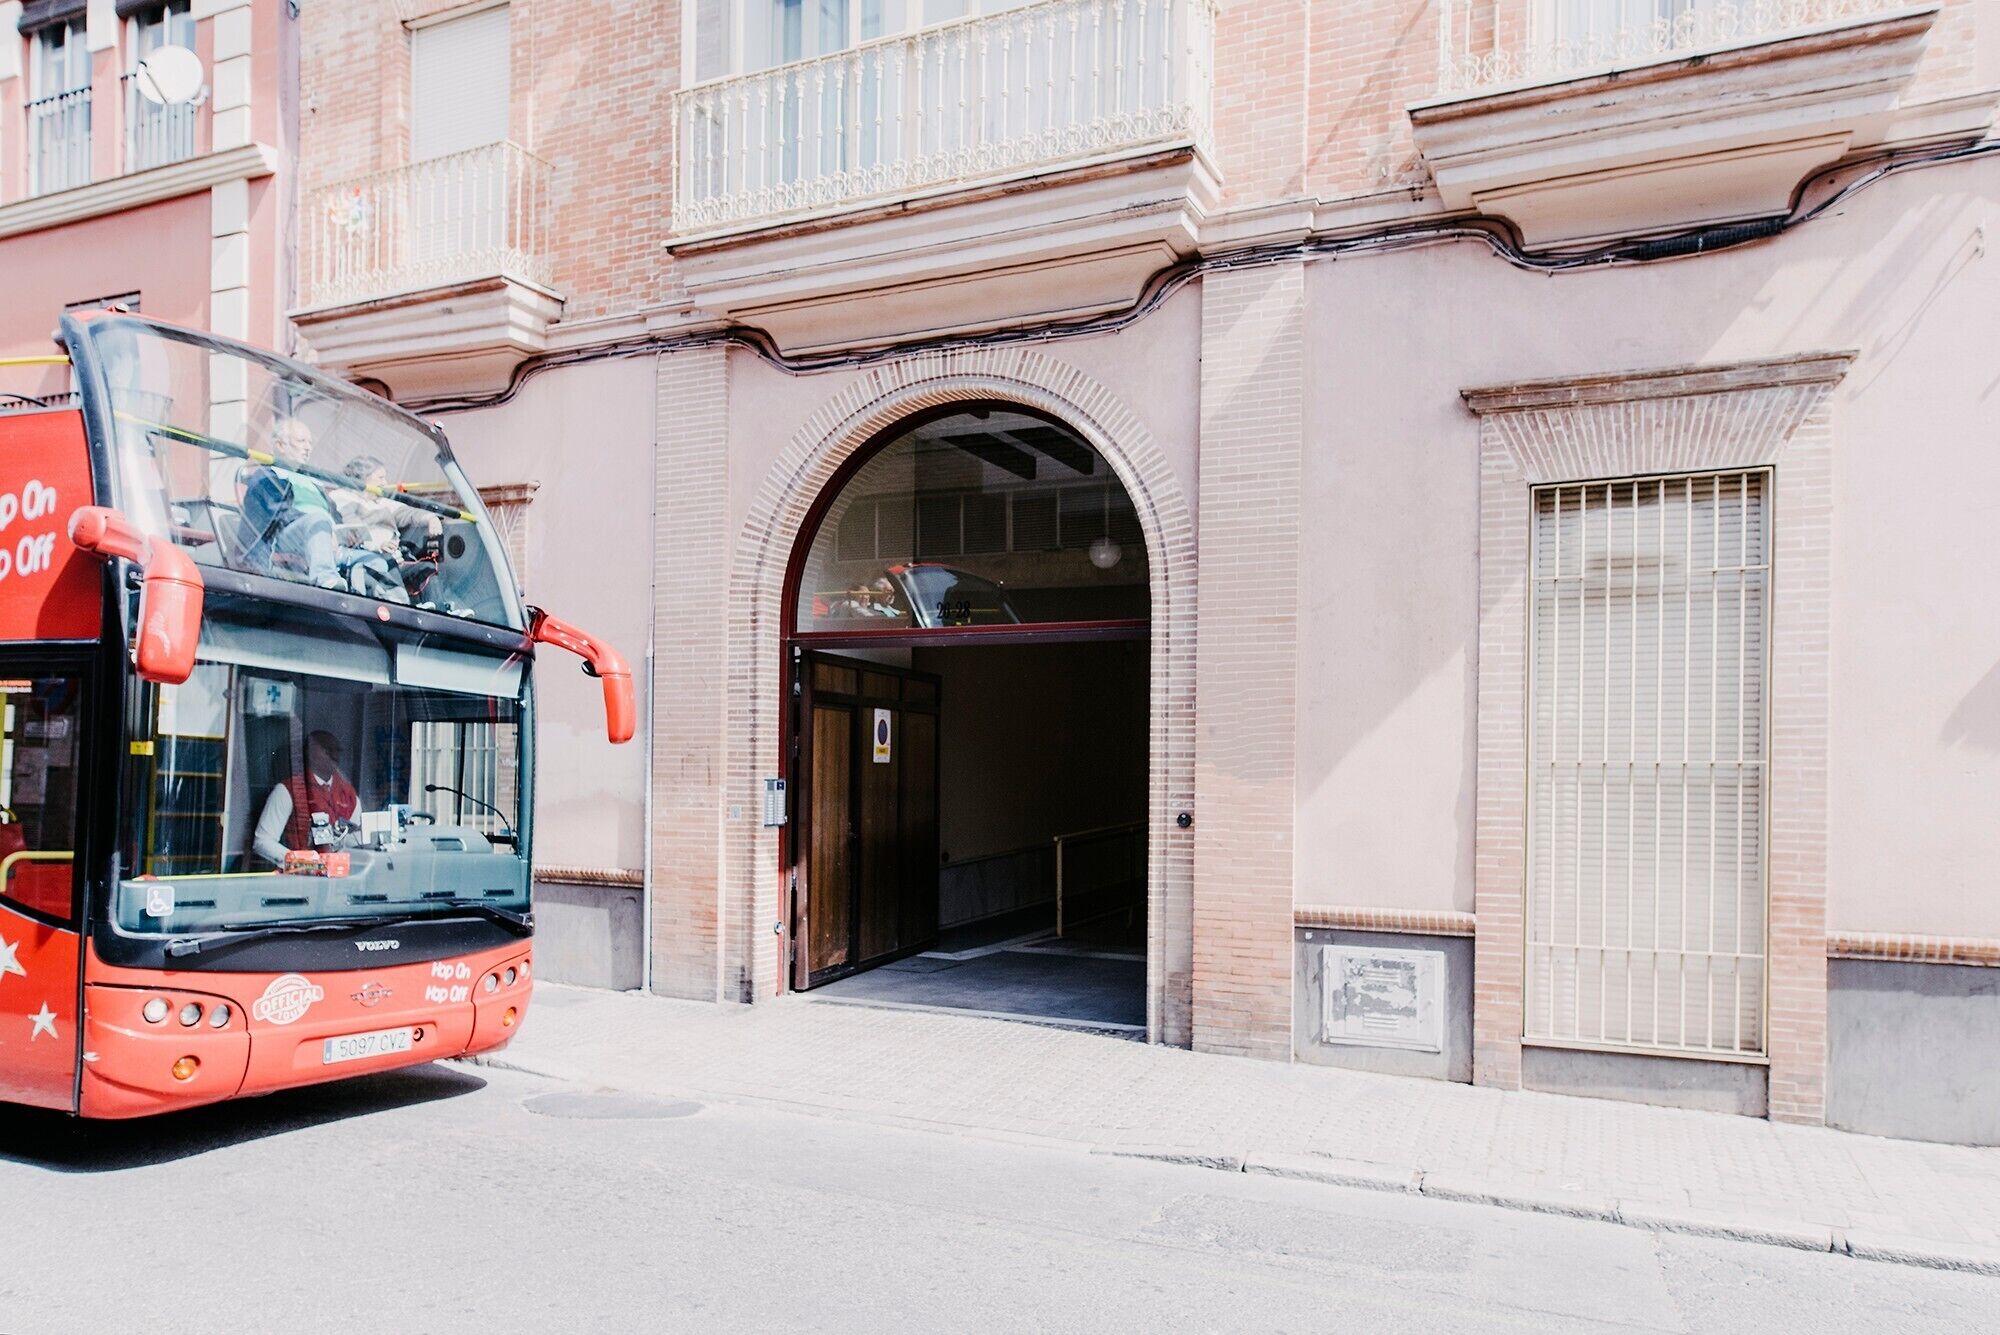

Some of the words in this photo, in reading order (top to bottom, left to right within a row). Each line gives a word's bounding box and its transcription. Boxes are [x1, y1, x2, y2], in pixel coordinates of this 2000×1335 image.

[22, 479, 57, 520] On
[15, 531, 57, 576] Off
[354, 940, 400, 952] VOLVO
[431, 961, 454, 980] Hop
[455, 961, 471, 979] On
[259, 987, 320, 1014] OFFICIAL
[424, 984, 448, 1003] Hop
[449, 984, 469, 1002] Off
[339, 1037, 376, 1058] 5097
[380, 1032, 406, 1052] CVZ
